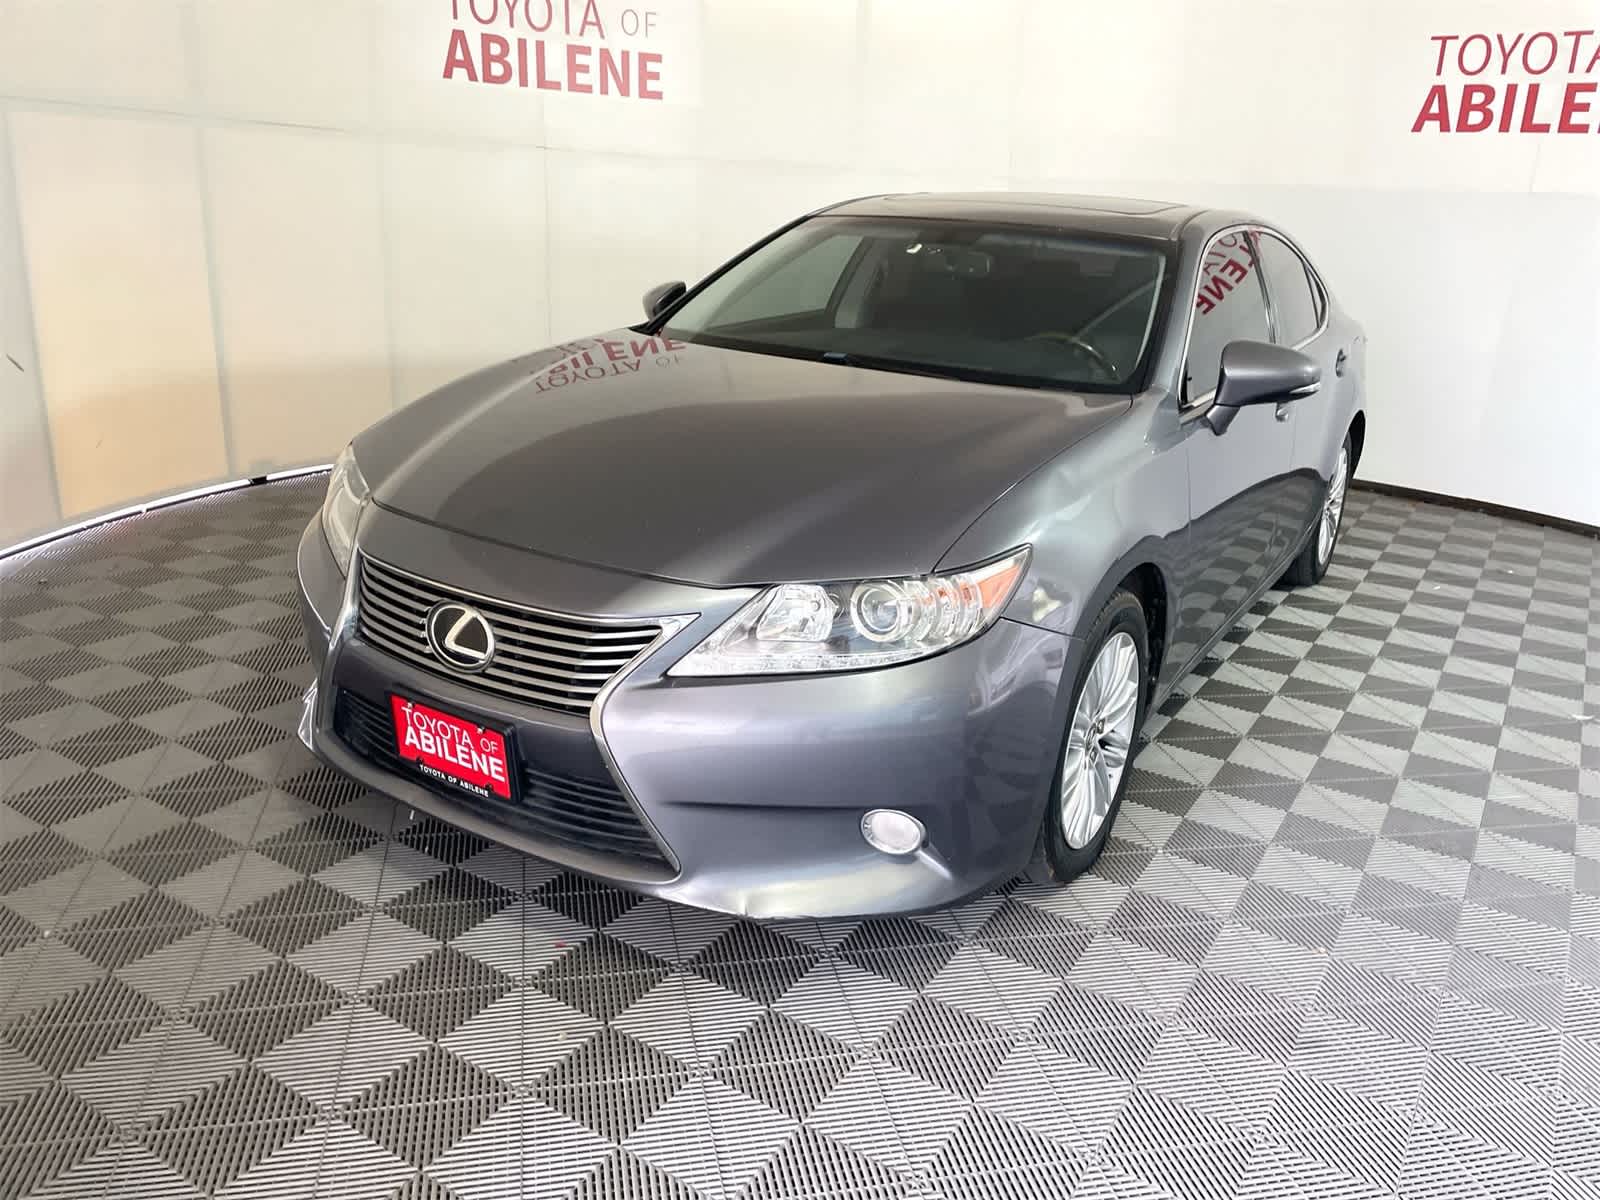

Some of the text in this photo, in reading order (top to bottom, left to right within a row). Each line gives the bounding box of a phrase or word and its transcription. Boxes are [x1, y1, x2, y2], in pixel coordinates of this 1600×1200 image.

[621, 9, 657, 37] OF
[443, 29, 663, 100] ABILENE
[1411, 82, 1600, 133] ABILE
[401, 706, 498, 754] TOYOTA OF
[405, 726, 505, 783] ABILENE
[419, 764, 446, 780] TOYOTA
[460, 780, 489, 798] ABILENE
